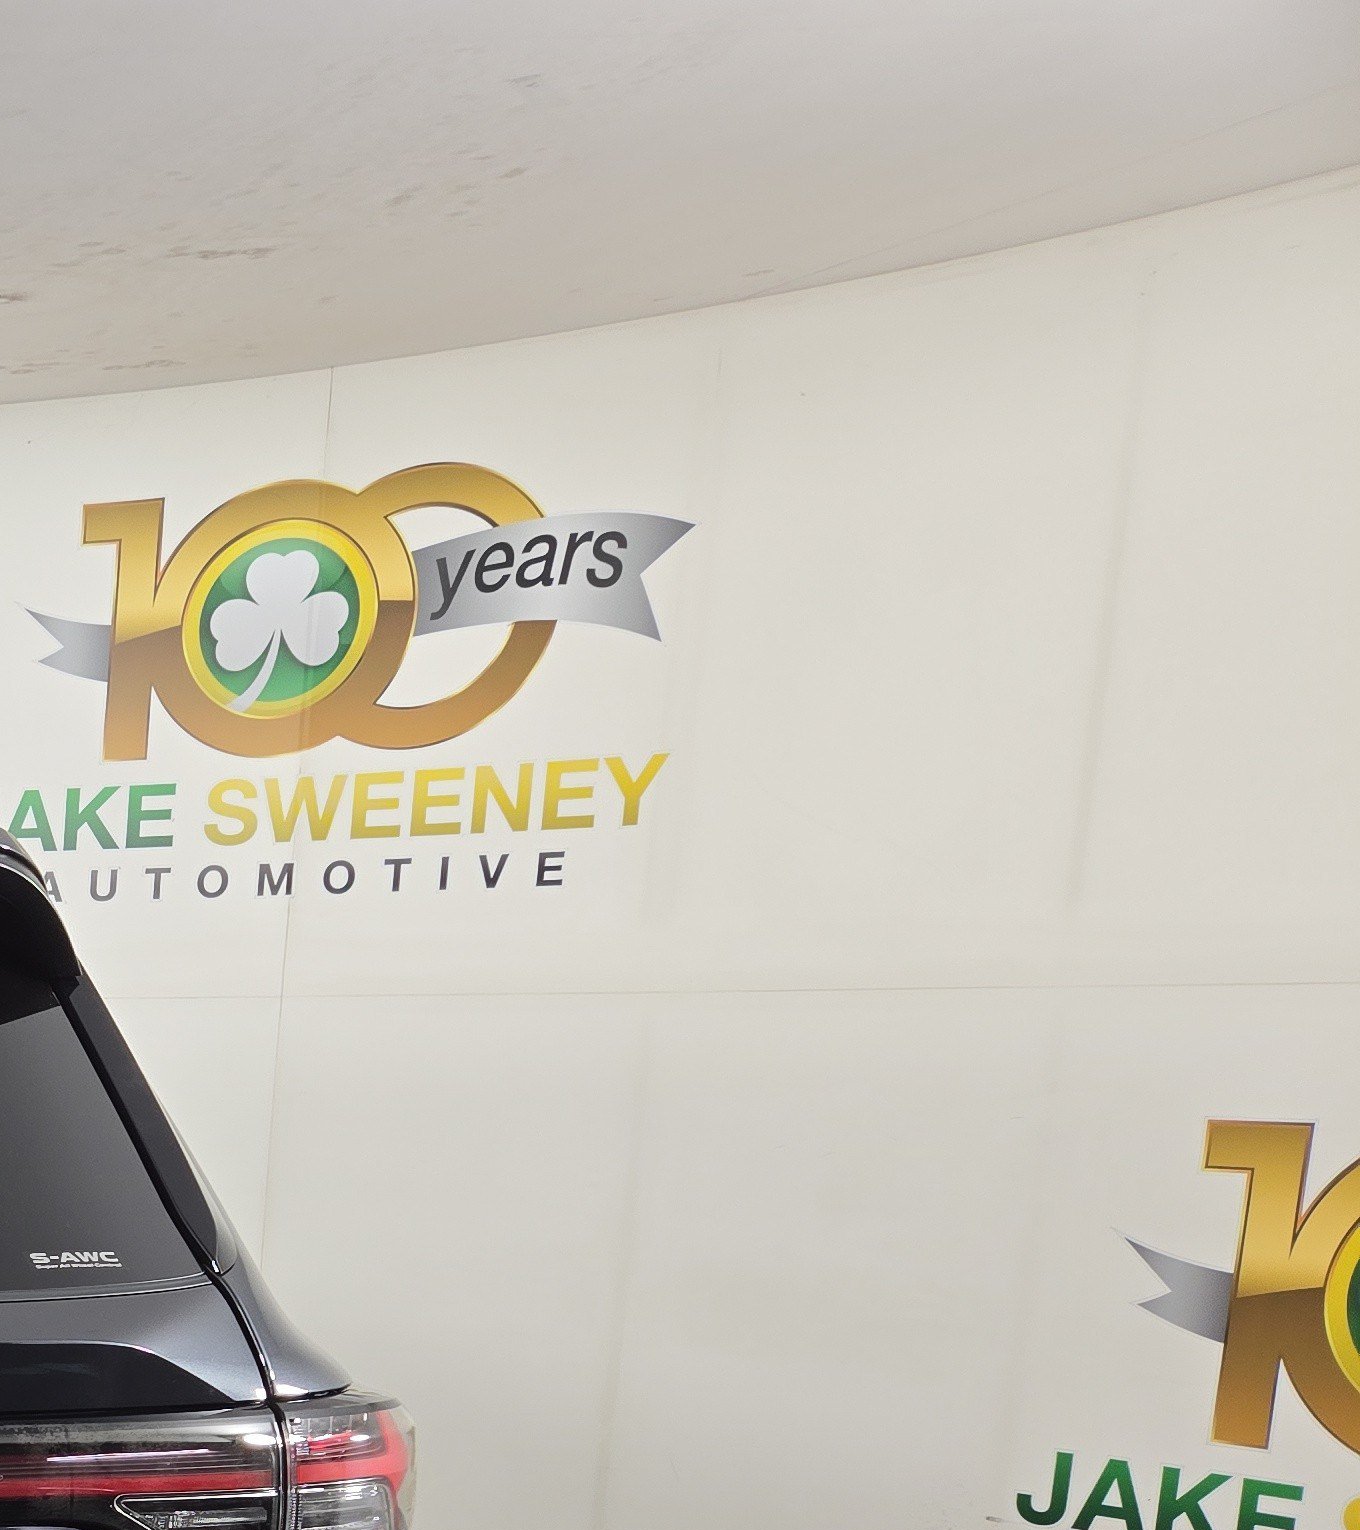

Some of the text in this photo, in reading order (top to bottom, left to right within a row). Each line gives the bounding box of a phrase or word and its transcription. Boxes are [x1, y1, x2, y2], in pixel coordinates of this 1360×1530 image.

[82, 462, 627, 761] 100 years
[204, 752, 671, 847] SWEENEY
[30, 1251, 119, 1264] S-AWC
